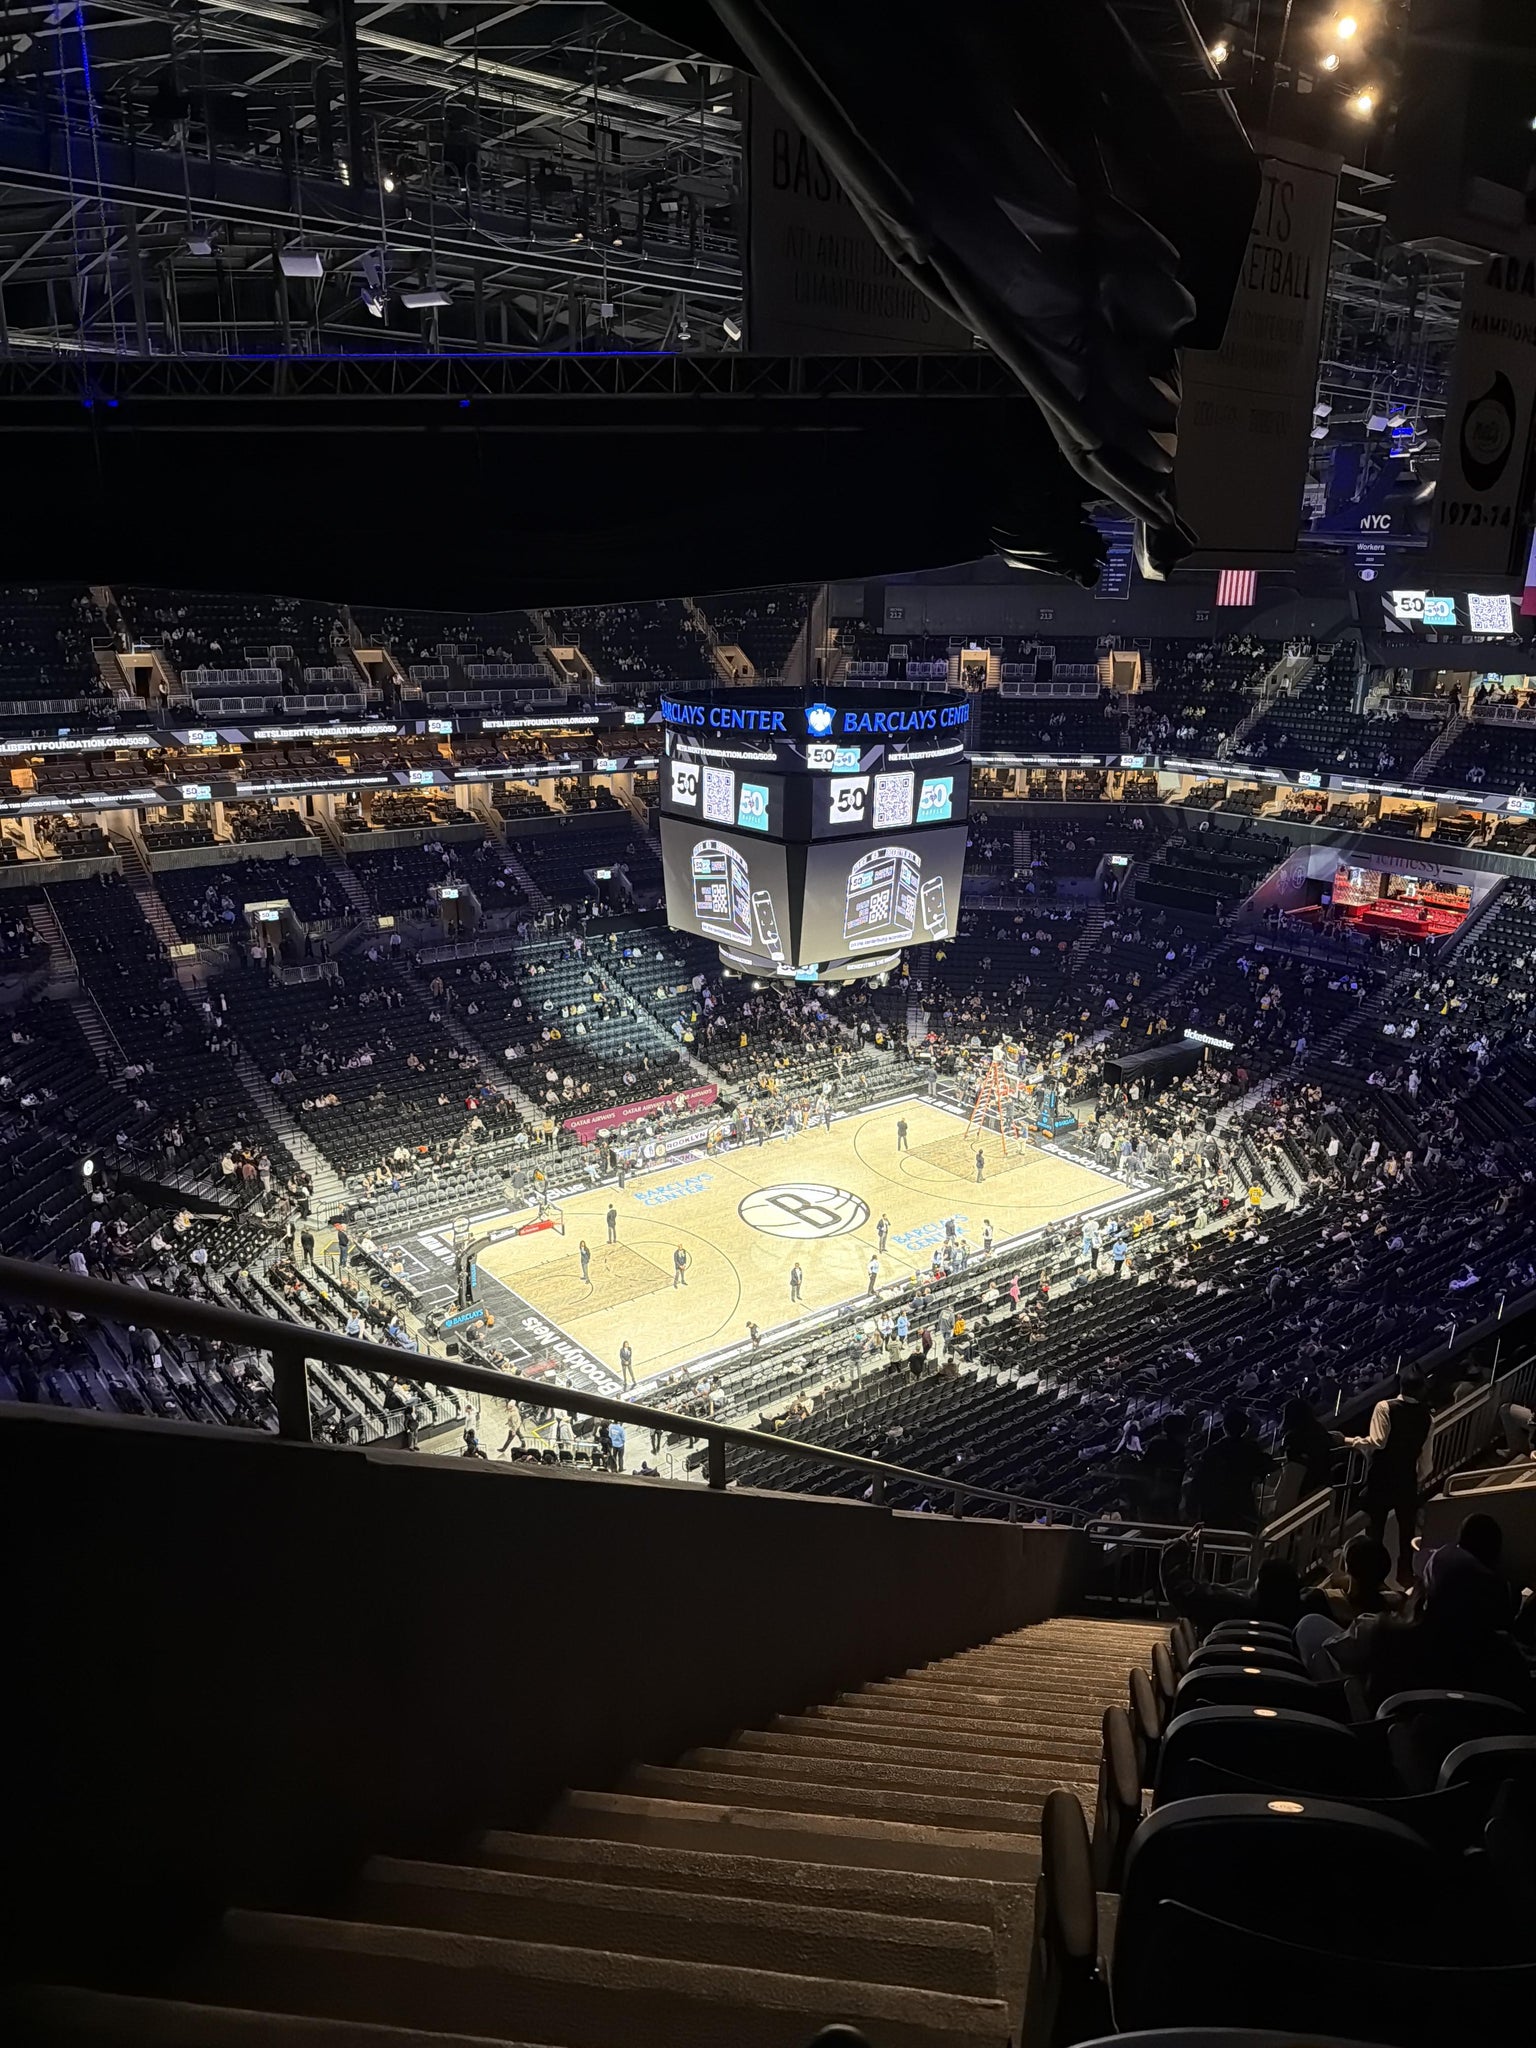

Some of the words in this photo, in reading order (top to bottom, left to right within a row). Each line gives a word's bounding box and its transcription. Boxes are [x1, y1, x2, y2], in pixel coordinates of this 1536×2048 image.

[773, 128, 851, 206] BAS
[1243, 244, 1310, 300] ETBALL
[794, 272, 931, 324] CHAMPIONSHIPS
[1360, 514, 1391, 529] NYC
[1357, 543, 1385, 551] Workers
[1400, 597, 1424, 612] 50
[1424, 600, 1450, 617] 50
[709, 707, 787, 732] CENTER
[843, 709, 937, 733] BARCLAYS
[254, 725, 397, 739] NETSLIBERTYFOUNDATION.ORG/5050
[813, 749, 835, 763] 50
[834, 752, 856, 767] 50
[677, 772, 697, 796] 50
[741, 788, 764, 816] 50
[837, 788, 866, 813] 50
[921, 784, 947, 809] 50
[1183, 1028, 1235, 1051] ticketmaster
[571, 1118, 591, 1128] QATAR
[591, 1112, 615, 1123] AIRWAYS
[622, 1106, 641, 1116] QATAR
[1041, 1142, 1110, 1174] Brooklyn
[634, 1172, 714, 1201] BARCLAYS
[644, 1184, 711, 1207] CENTER
[765, 1193, 842, 1229] B
[906, 1226, 971, 1252] CENTR
[452, 1309, 484, 1326] BARCLAYS
[522, 1316, 561, 1345] Nets
[553, 1341, 622, 1396] Brooklyn
